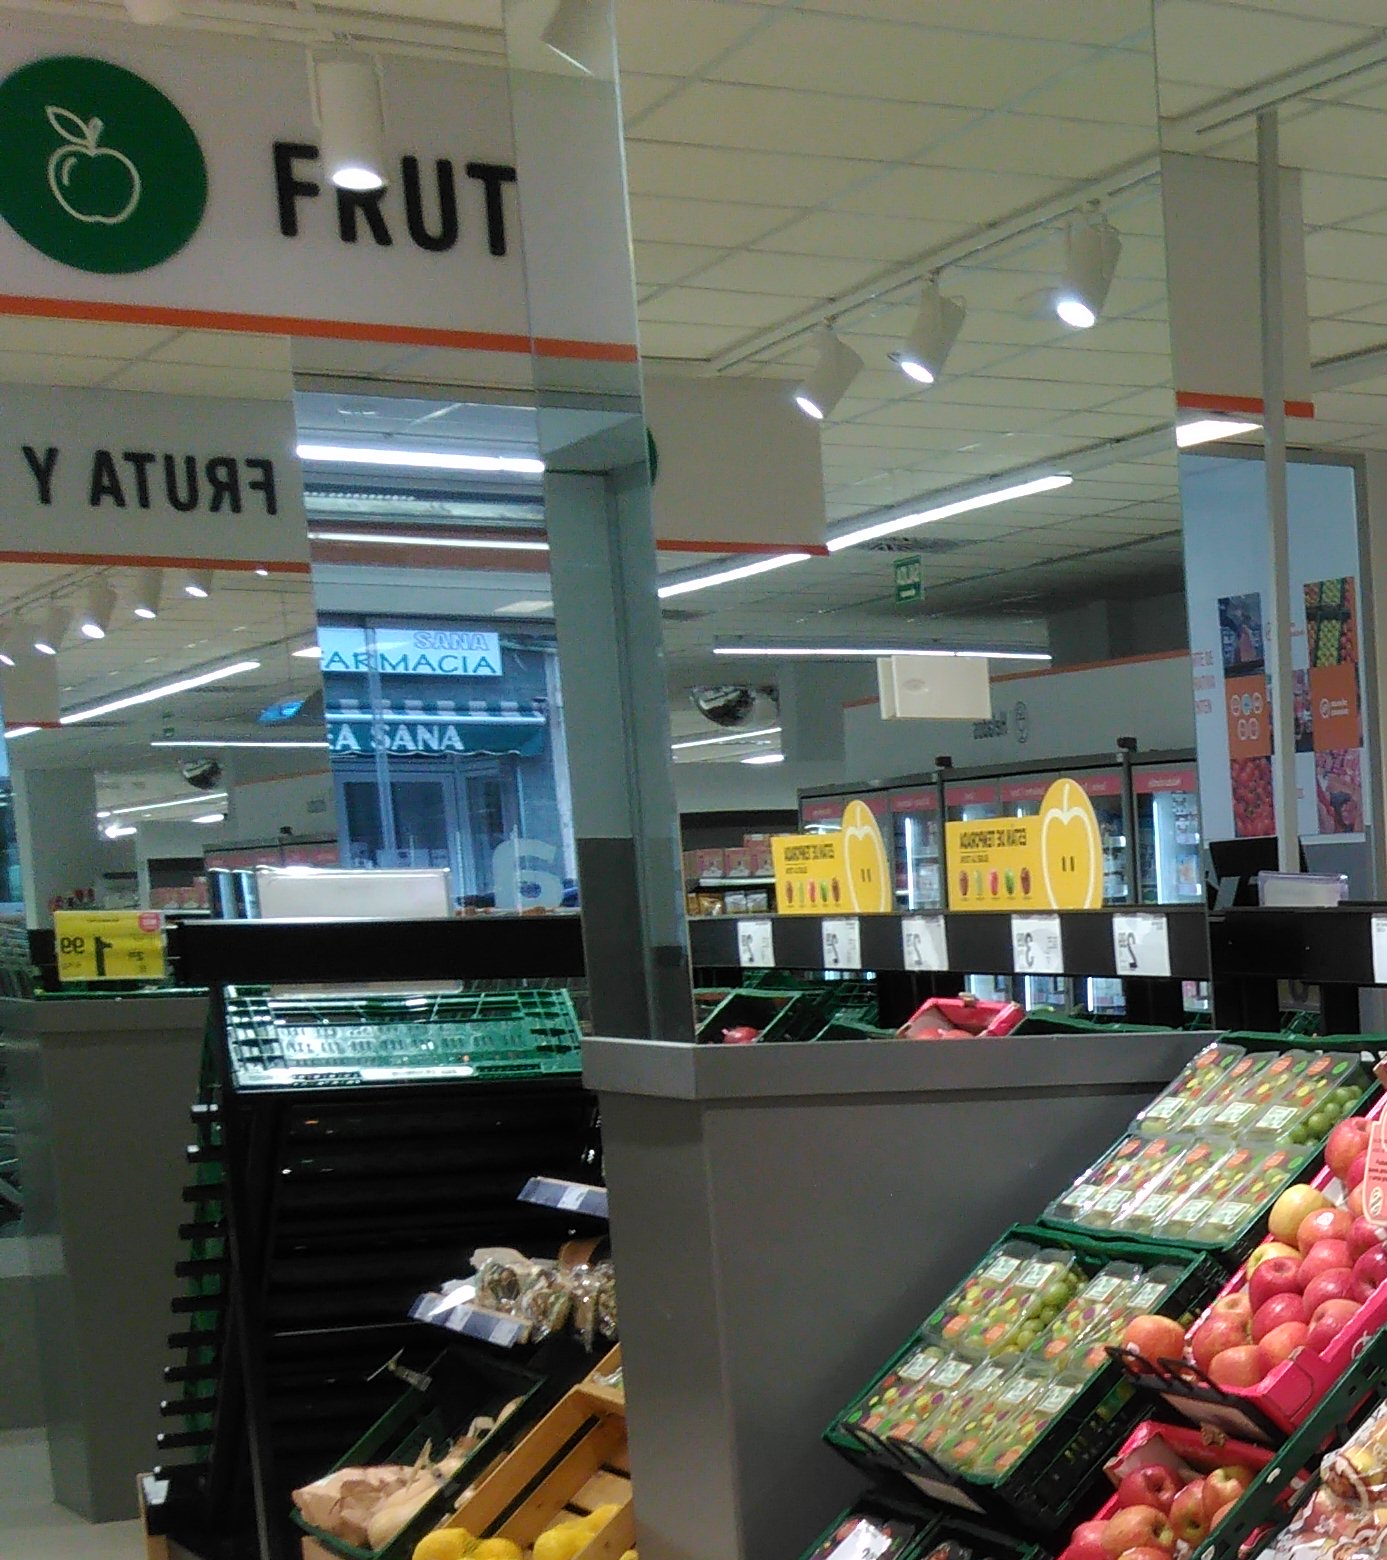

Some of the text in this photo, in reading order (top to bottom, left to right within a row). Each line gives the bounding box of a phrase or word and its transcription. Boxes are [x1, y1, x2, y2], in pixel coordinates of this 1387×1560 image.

[413, 631, 490, 651] SANA
[322, 650, 497, 674] ARMACIA
[371, 723, 464, 751] SANA
